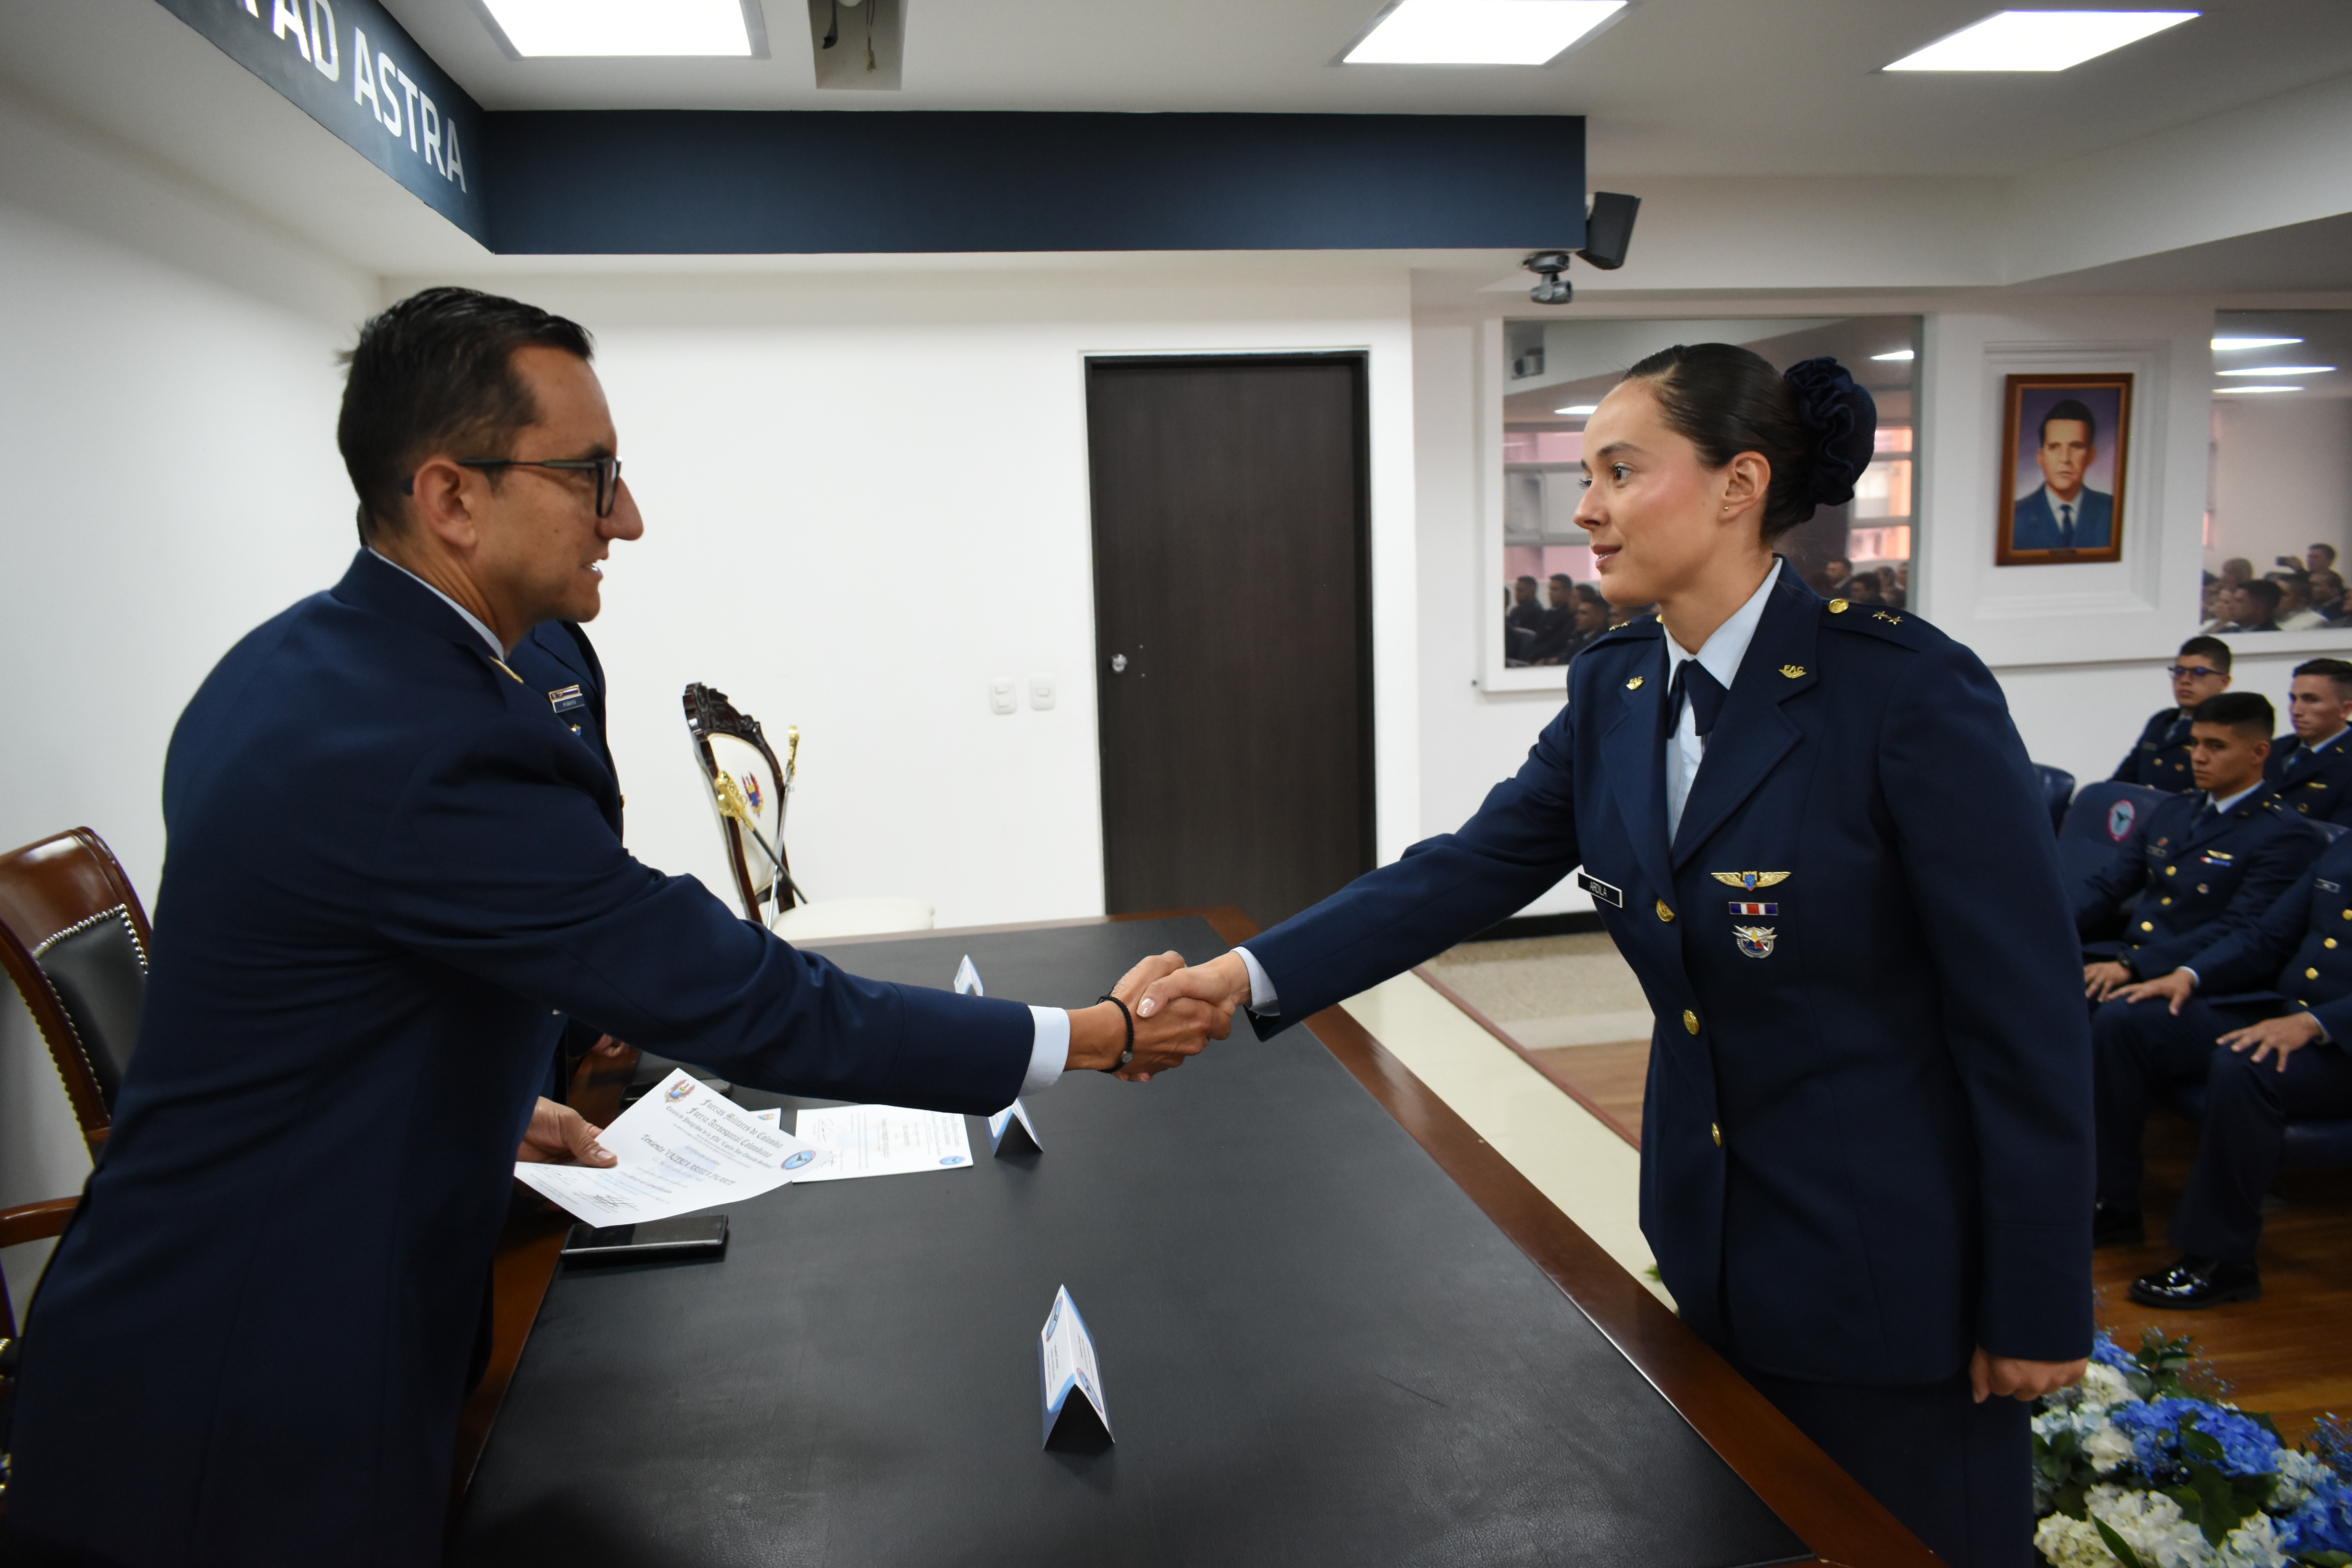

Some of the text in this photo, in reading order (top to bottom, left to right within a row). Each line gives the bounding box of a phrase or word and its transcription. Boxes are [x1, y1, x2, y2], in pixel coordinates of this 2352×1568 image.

[354, 27, 467, 193] ASTRA
[1589, 880, 1608, 898] ARDILA
[641, 1134, 665, 1153] Teniente
[686, 1107, 709, 1123] Fuerza
[708, 1119, 744, 1142] Aeroespacial
[740, 1139, 772, 1158] Colombiana
[700, 1099, 726, 1116] Fuerzas
[723, 1113, 751, 1132] Militares
[757, 1132, 783, 1149] Colombia
